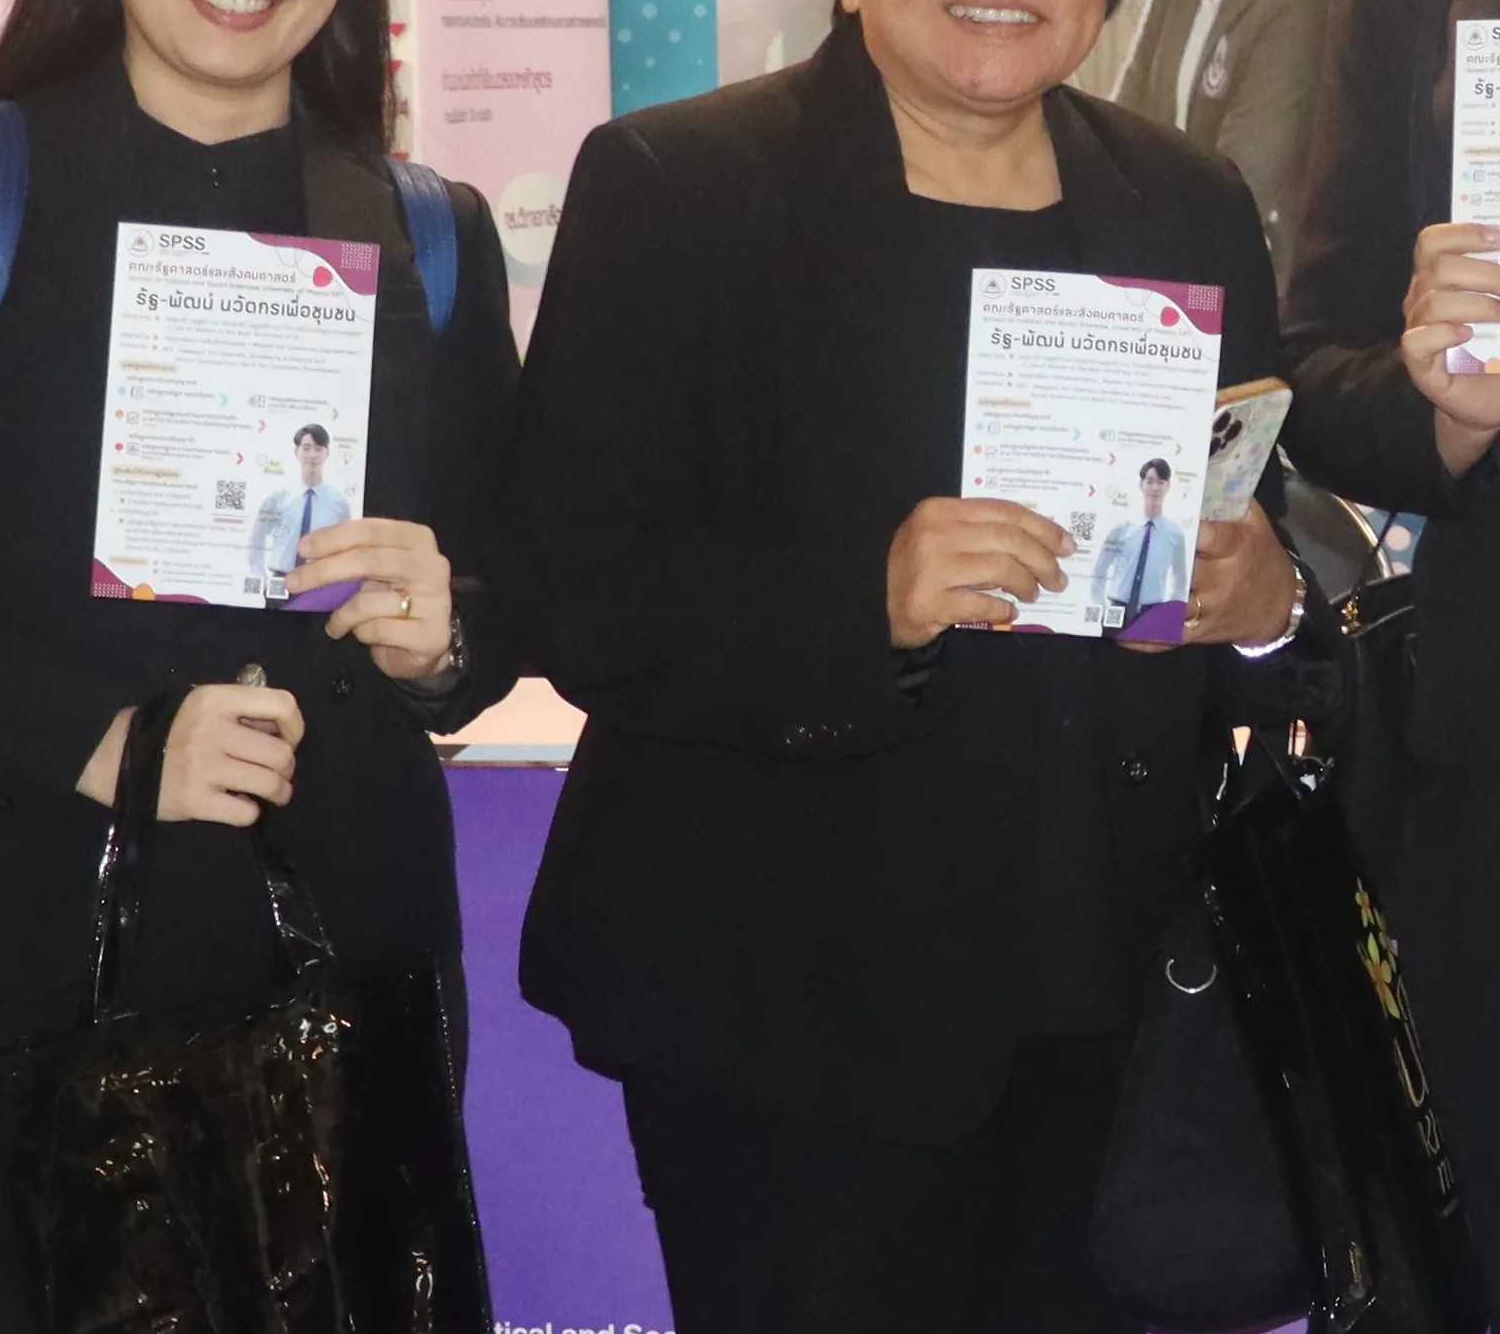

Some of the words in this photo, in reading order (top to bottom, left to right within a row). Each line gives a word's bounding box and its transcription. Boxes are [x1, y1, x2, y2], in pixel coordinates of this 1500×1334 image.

[159, 234, 206, 251] SPSS
[1011, 276, 1056, 292] SPSS
[135, 287, 214, 311] รัฐ-พัฒน์
[990, 327, 1065, 350] รัฐ-พัฒน์
